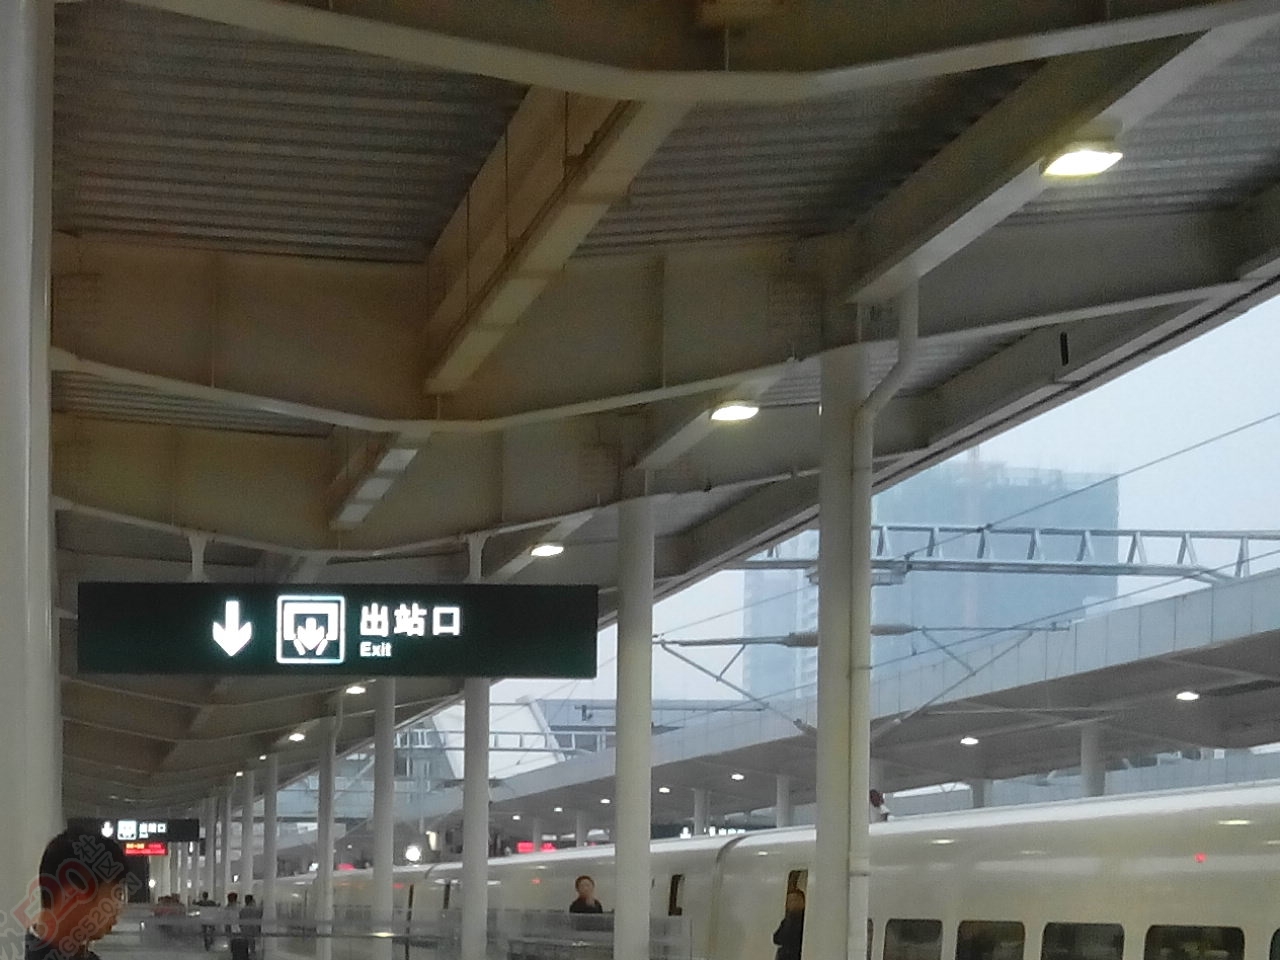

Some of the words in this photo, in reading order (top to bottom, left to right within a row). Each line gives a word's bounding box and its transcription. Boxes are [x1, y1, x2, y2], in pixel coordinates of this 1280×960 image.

[361, 602, 461, 637] 出站口
[360, 641, 392, 657] Exit
